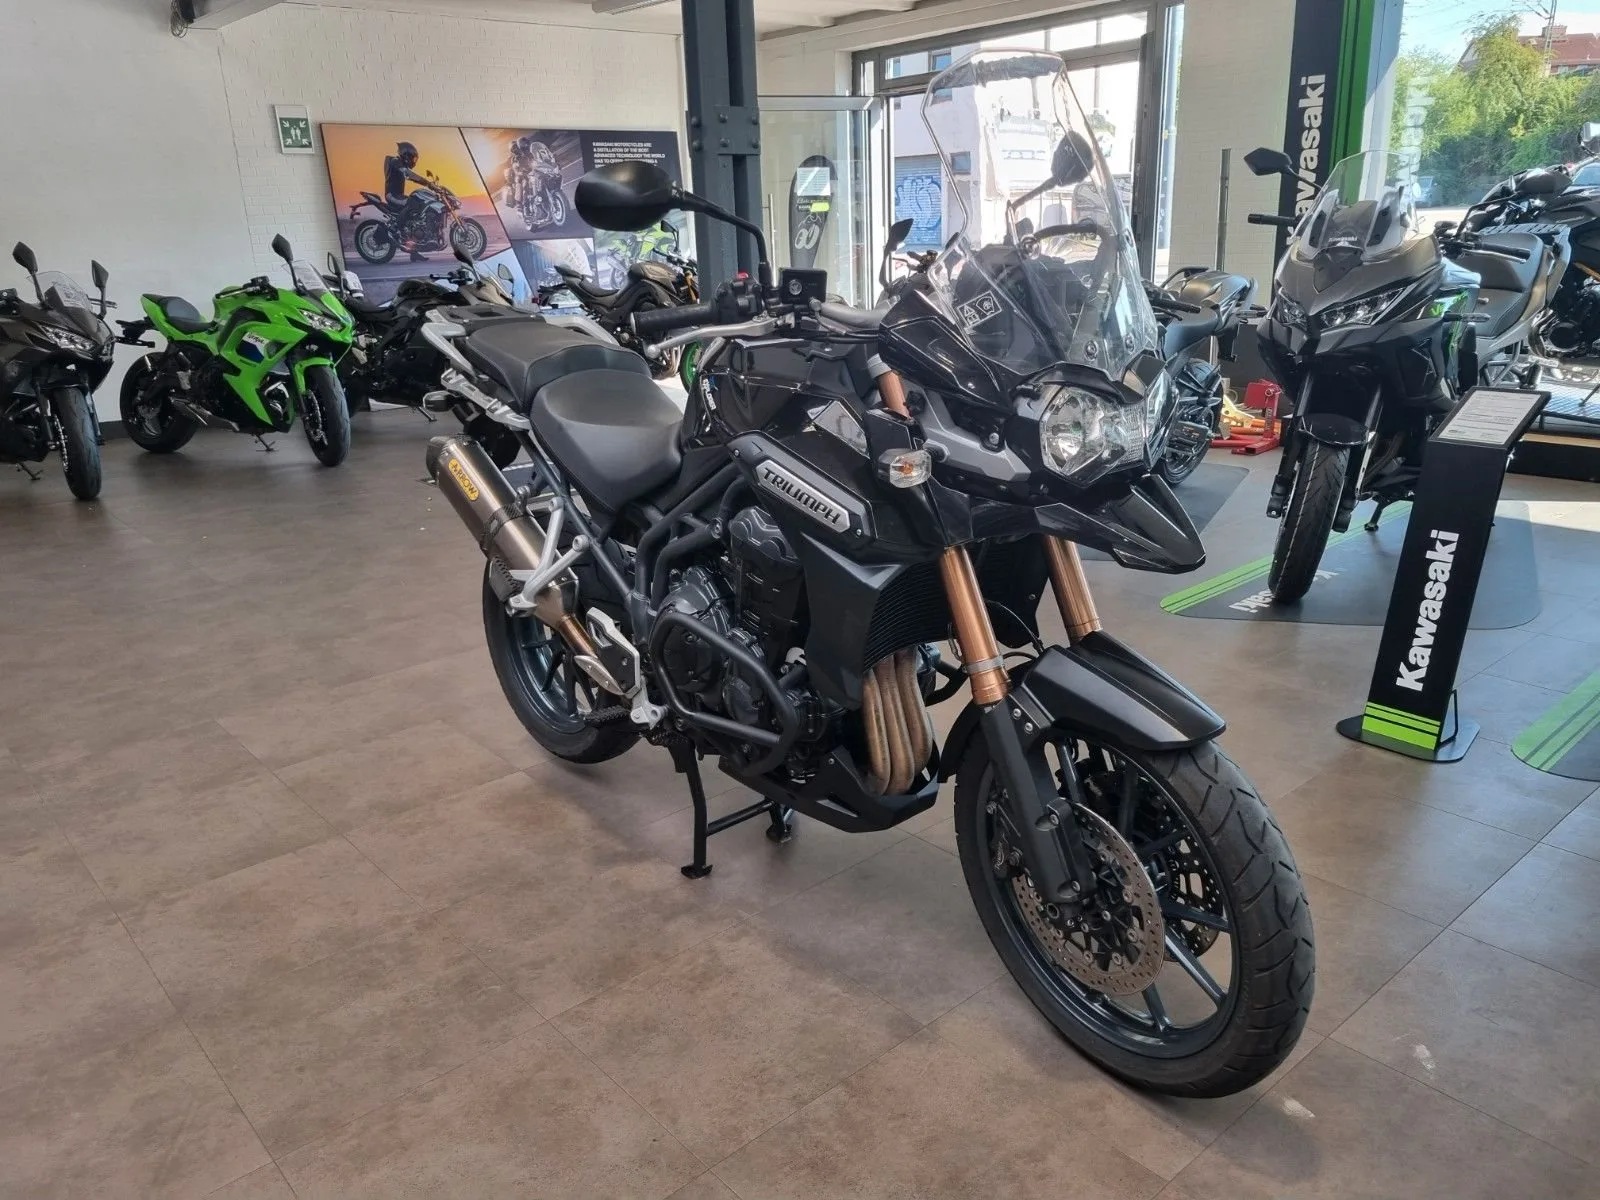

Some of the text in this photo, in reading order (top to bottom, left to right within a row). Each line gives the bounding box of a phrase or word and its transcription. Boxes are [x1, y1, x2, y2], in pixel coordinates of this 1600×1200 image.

[451, 461, 478, 497] ARROW
[763, 467, 841, 525] TRIUMPH
[1395, 529, 1460, 692] Kawasaki
